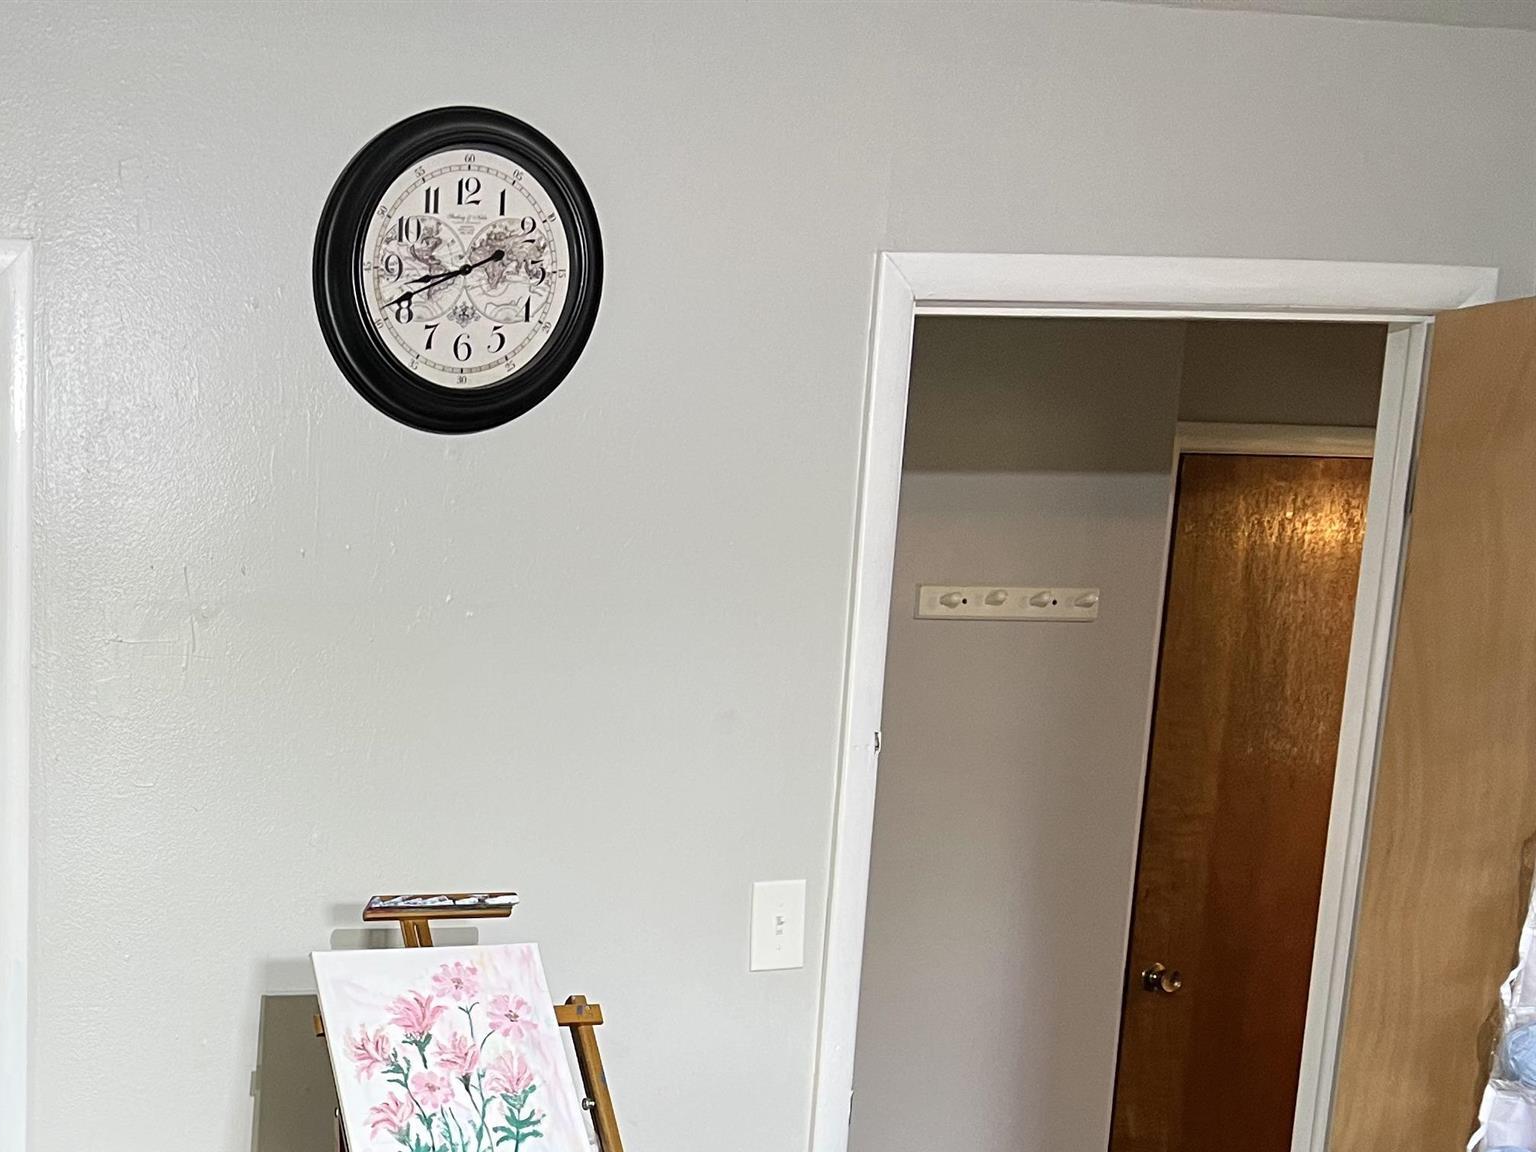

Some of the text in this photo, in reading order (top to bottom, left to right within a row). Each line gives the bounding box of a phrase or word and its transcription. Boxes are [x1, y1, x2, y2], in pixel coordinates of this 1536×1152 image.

[414, 167, 426, 178] 55
[464, 154, 476, 163] 60
[513, 169, 524, 182] 05
[425, 186, 440, 214] 11
[457, 176, 481, 206] 12
[499, 188, 506, 216] 1
[398, 215, 421, 244] 10
[520, 216, 537, 244] 2
[384, 254, 403, 283] 9
[529, 259, 546, 286] 3
[395, 295, 414, 324] 8
[515, 295, 532, 323] 4
[424, 323, 440, 350] 7
[453, 333, 472, 361] 6
[487, 325, 505, 353] 5
[456, 375, 467, 385] 30
